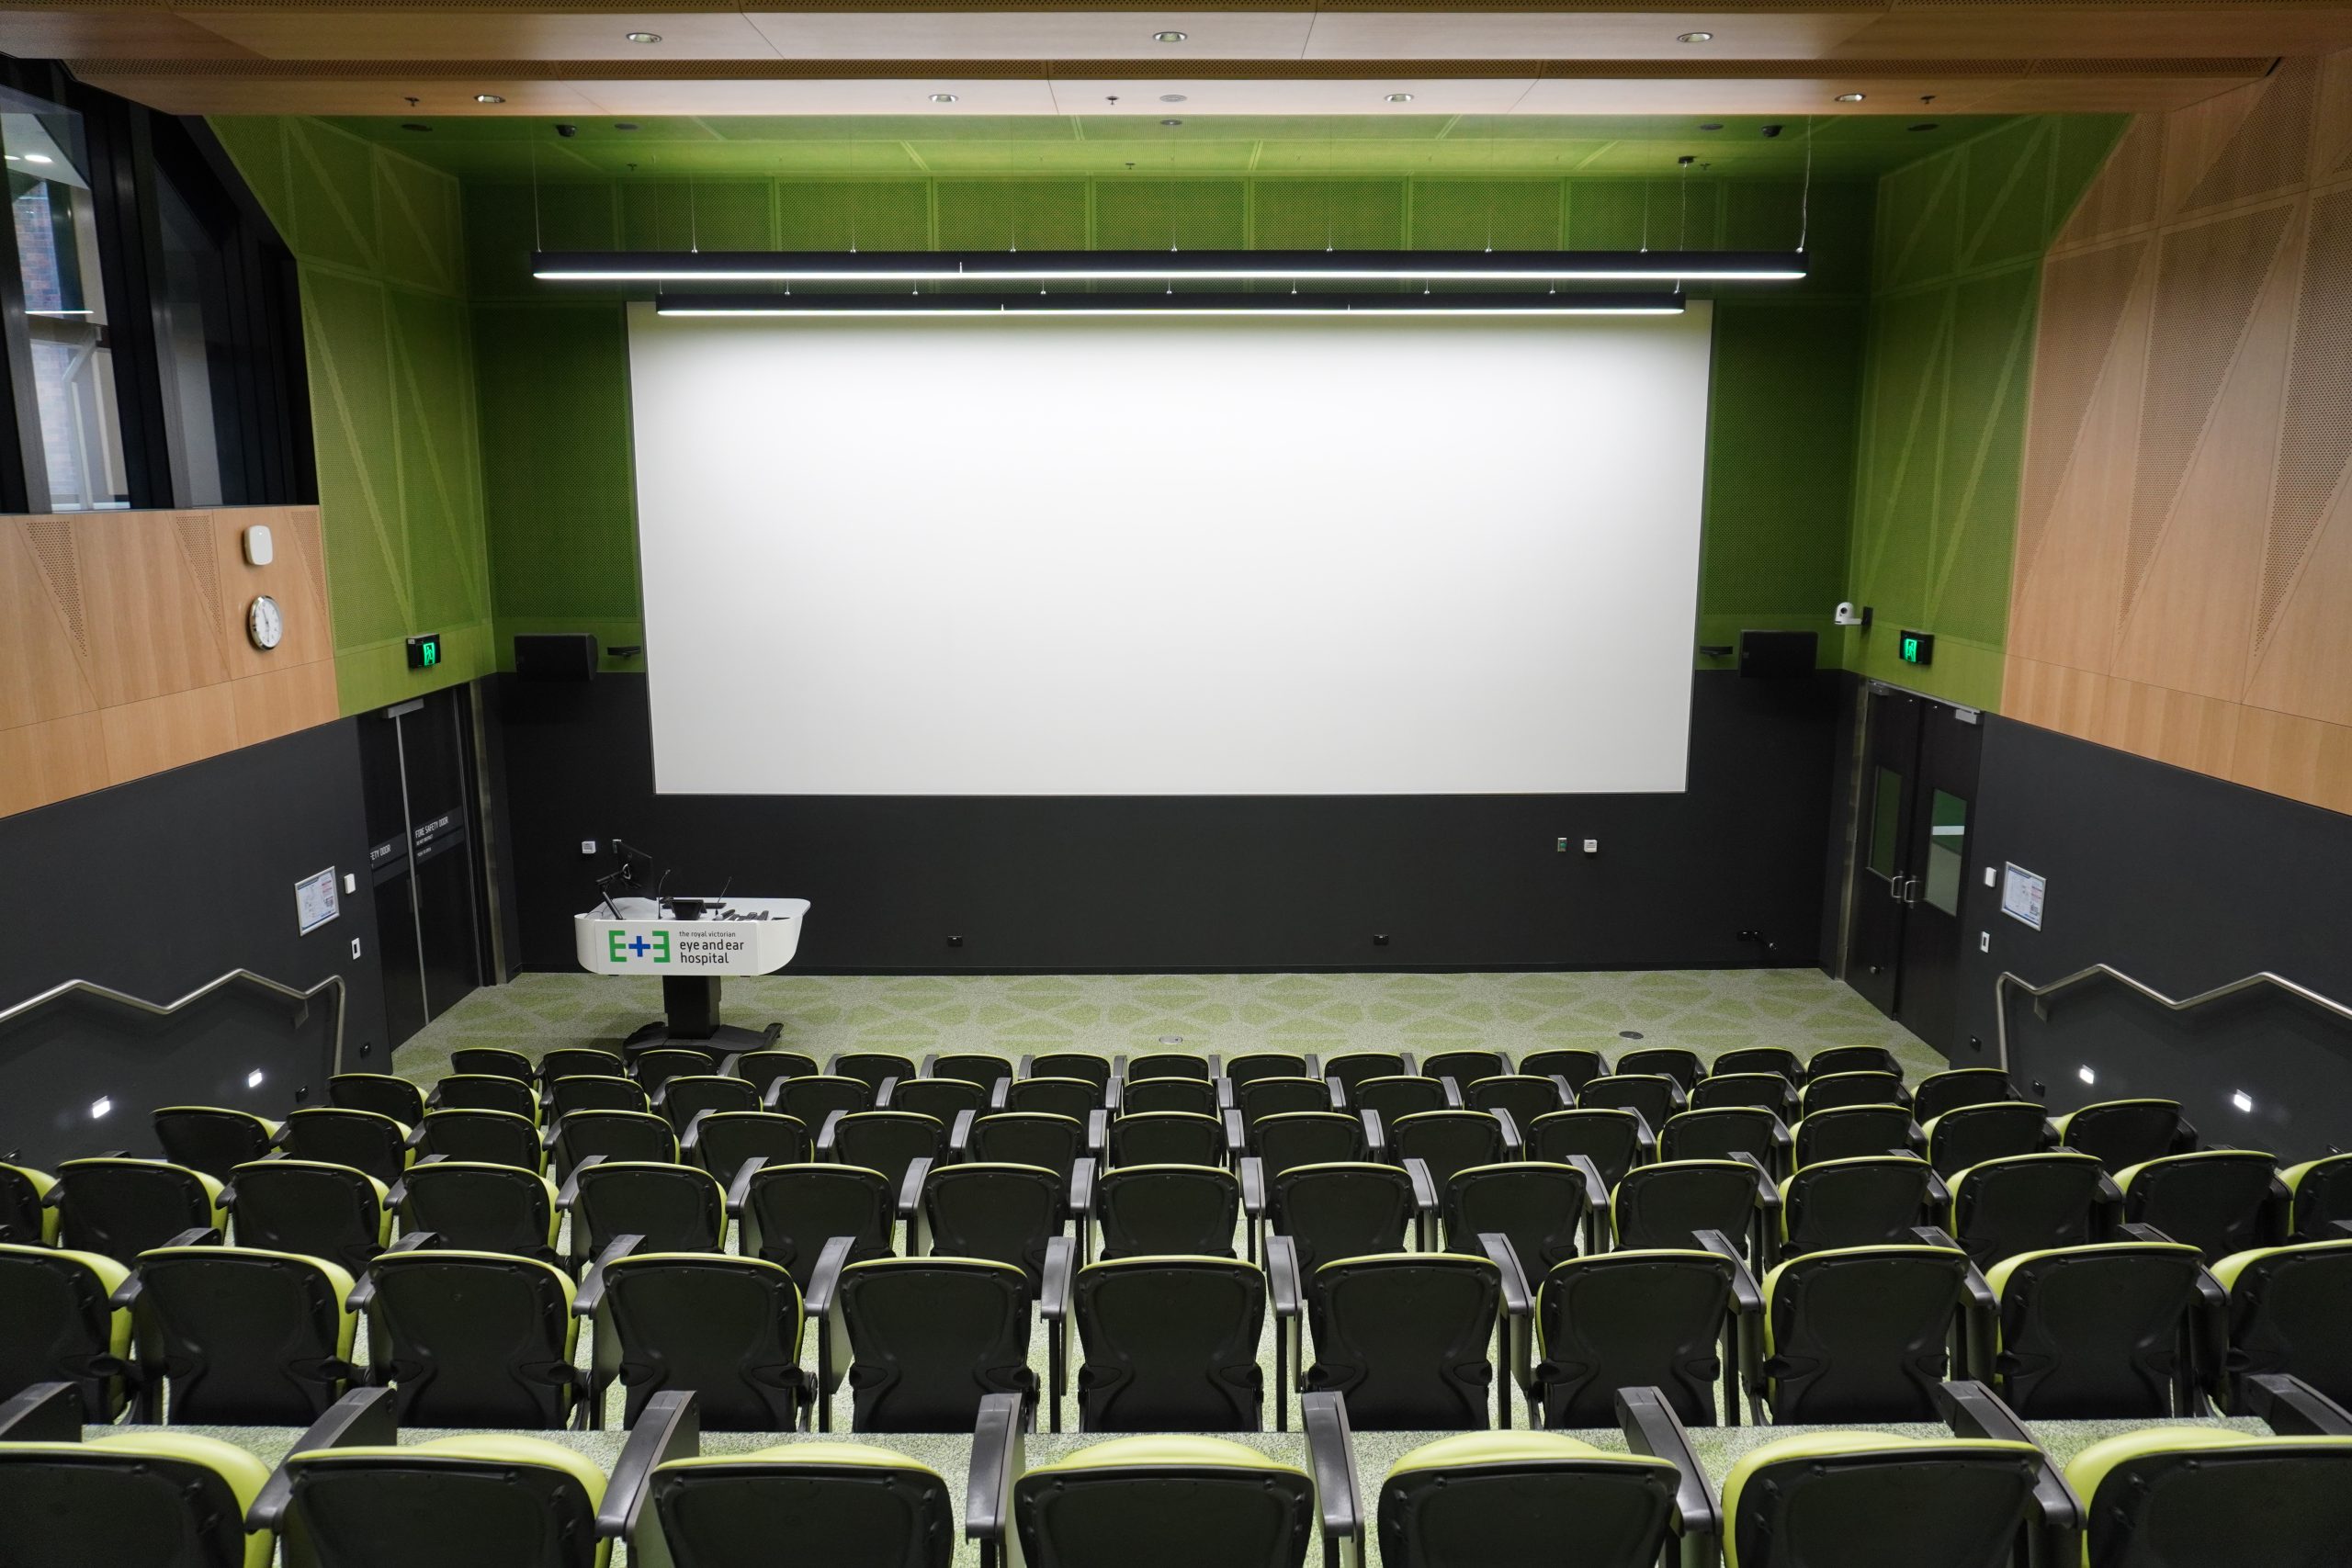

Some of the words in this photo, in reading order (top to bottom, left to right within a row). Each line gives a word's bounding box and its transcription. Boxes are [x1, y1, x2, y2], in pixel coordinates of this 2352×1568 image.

[415, 828, 425, 839] FIRE
[425, 821, 438, 833] SAFETY
[439, 817, 448, 828] DOOR
[380, 844, 391, 856] DOOR
[680, 942, 700, 953] eye
[702, 939, 724, 951] and
[725, 942, 744, 951] ear
[680, 952, 729, 965] hospital
